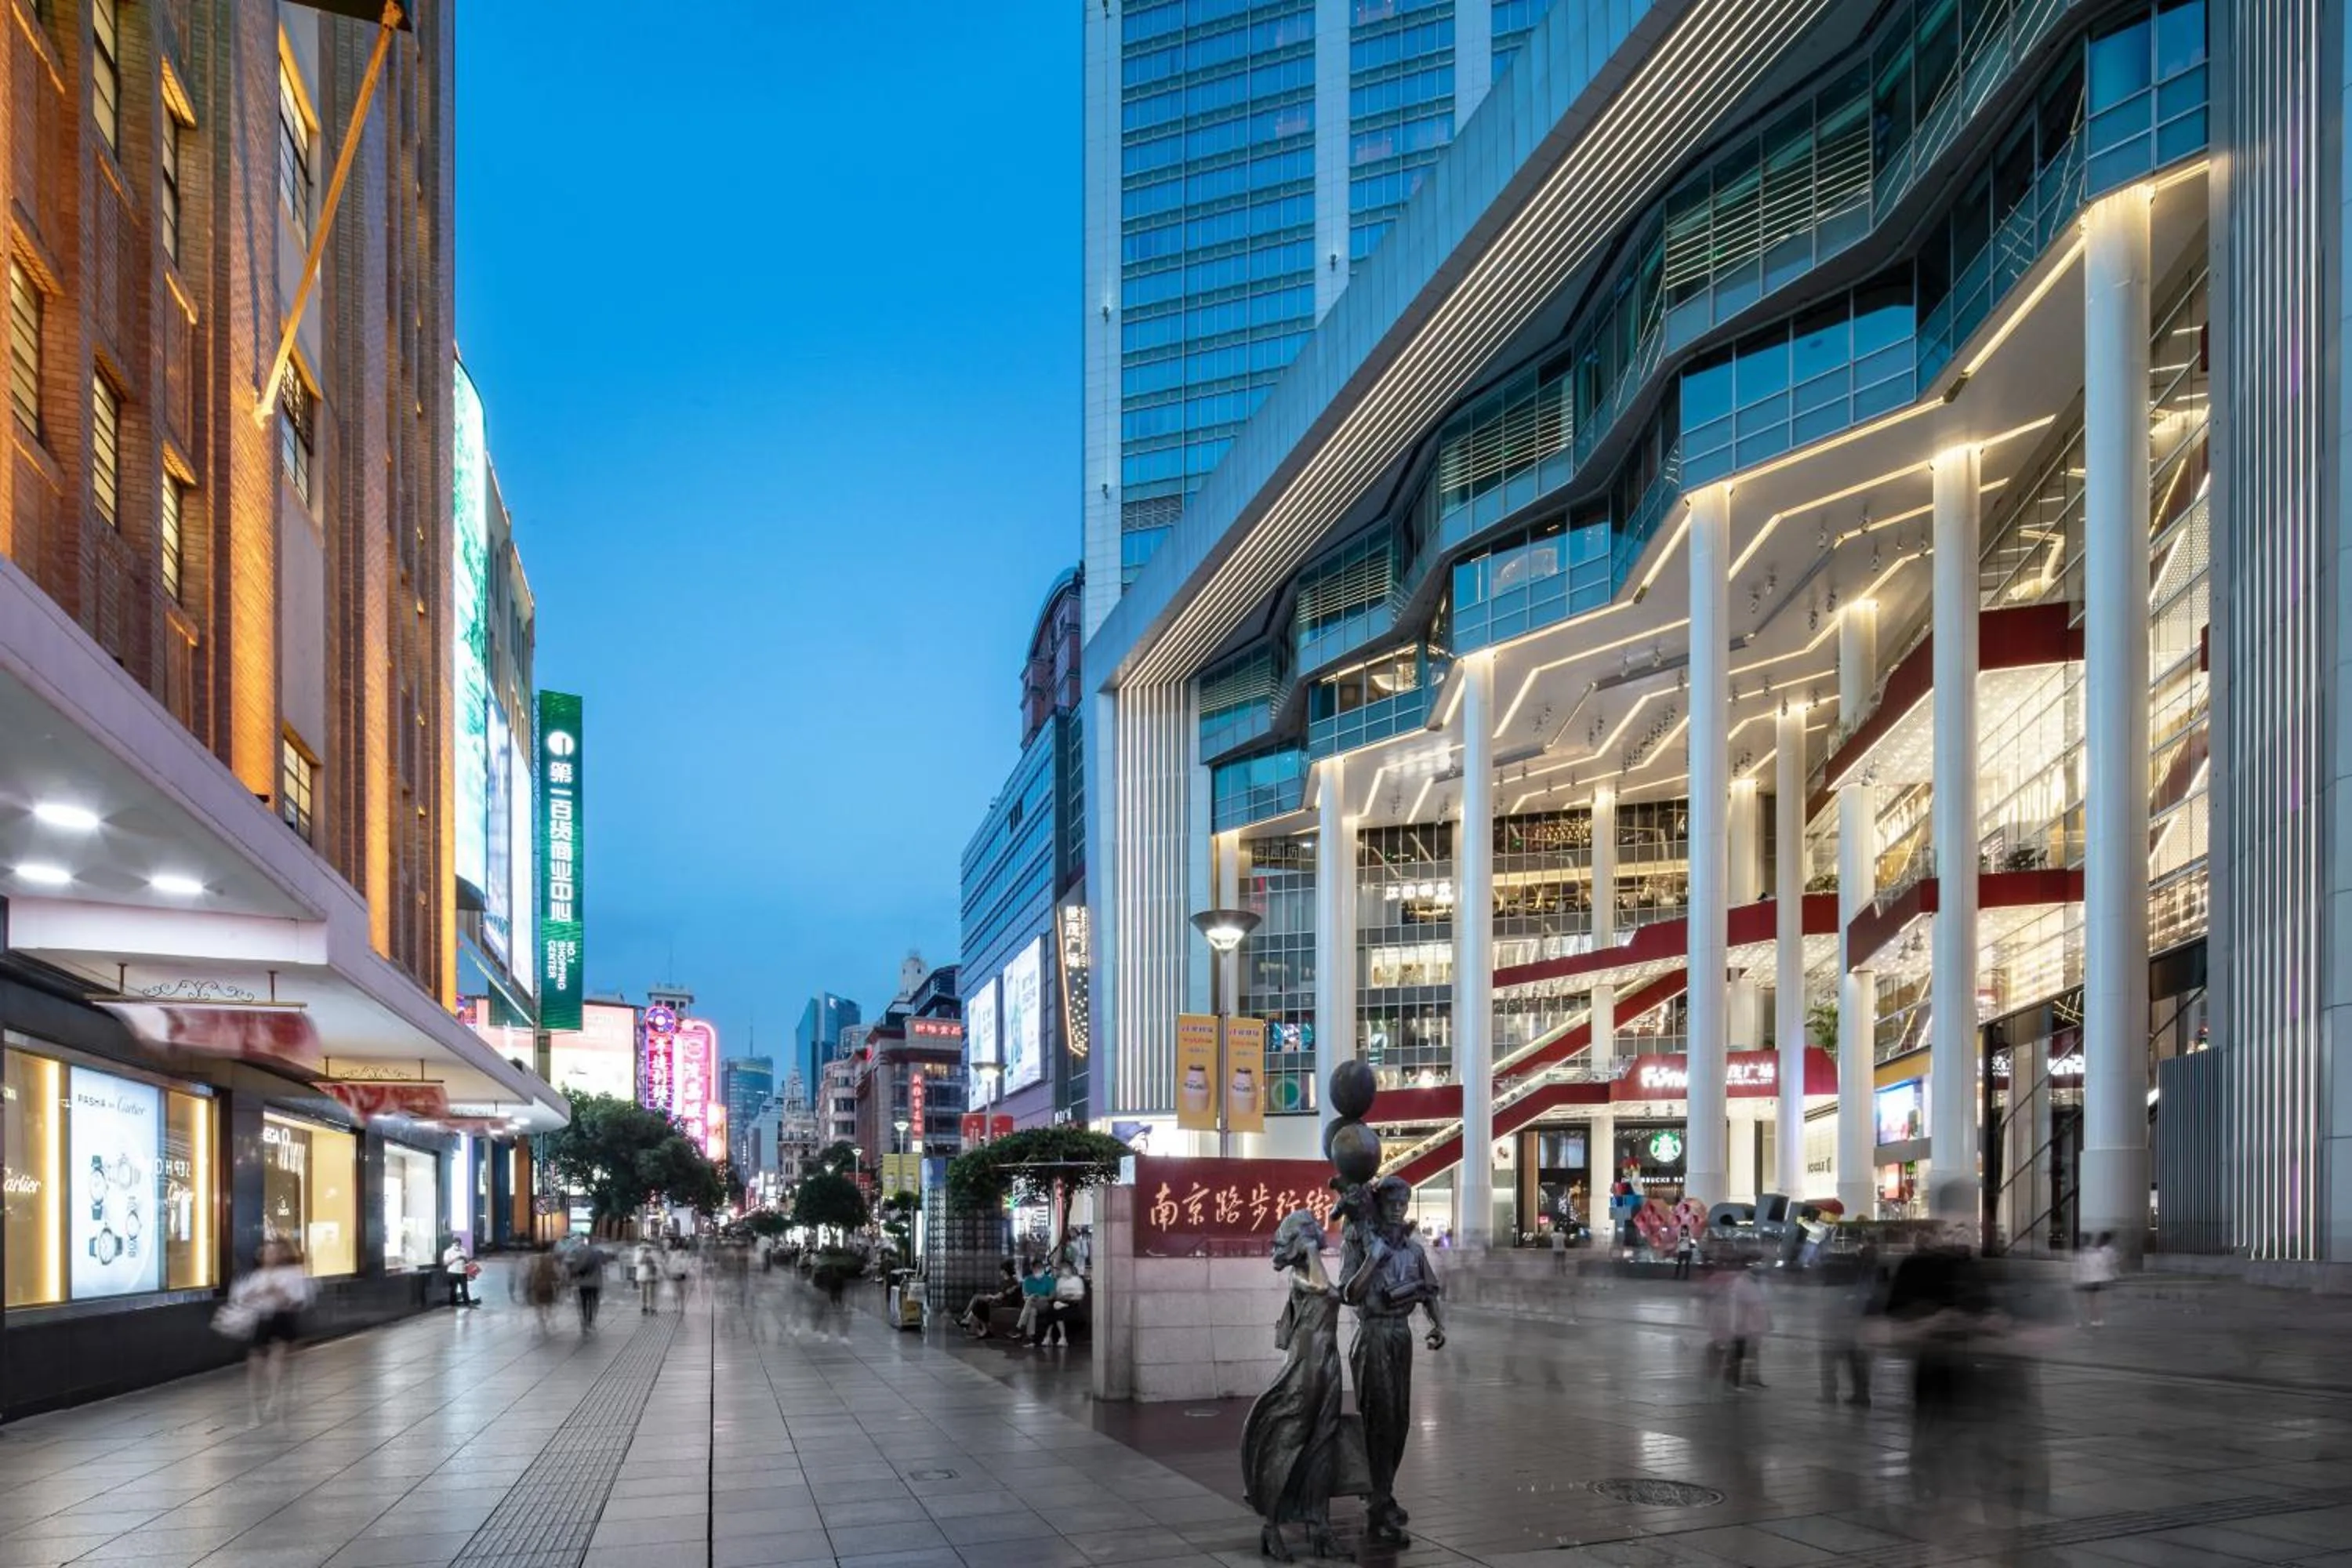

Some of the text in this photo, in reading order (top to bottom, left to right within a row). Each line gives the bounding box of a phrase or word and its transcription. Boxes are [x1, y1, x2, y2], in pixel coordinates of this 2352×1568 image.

[78, 1094, 106, 1108] PASHA
[117, 1095, 147, 1116] Cartier
[3, 1173, 42, 1194] artier
[1149, 1181, 1334, 1232] 南京路步行街
